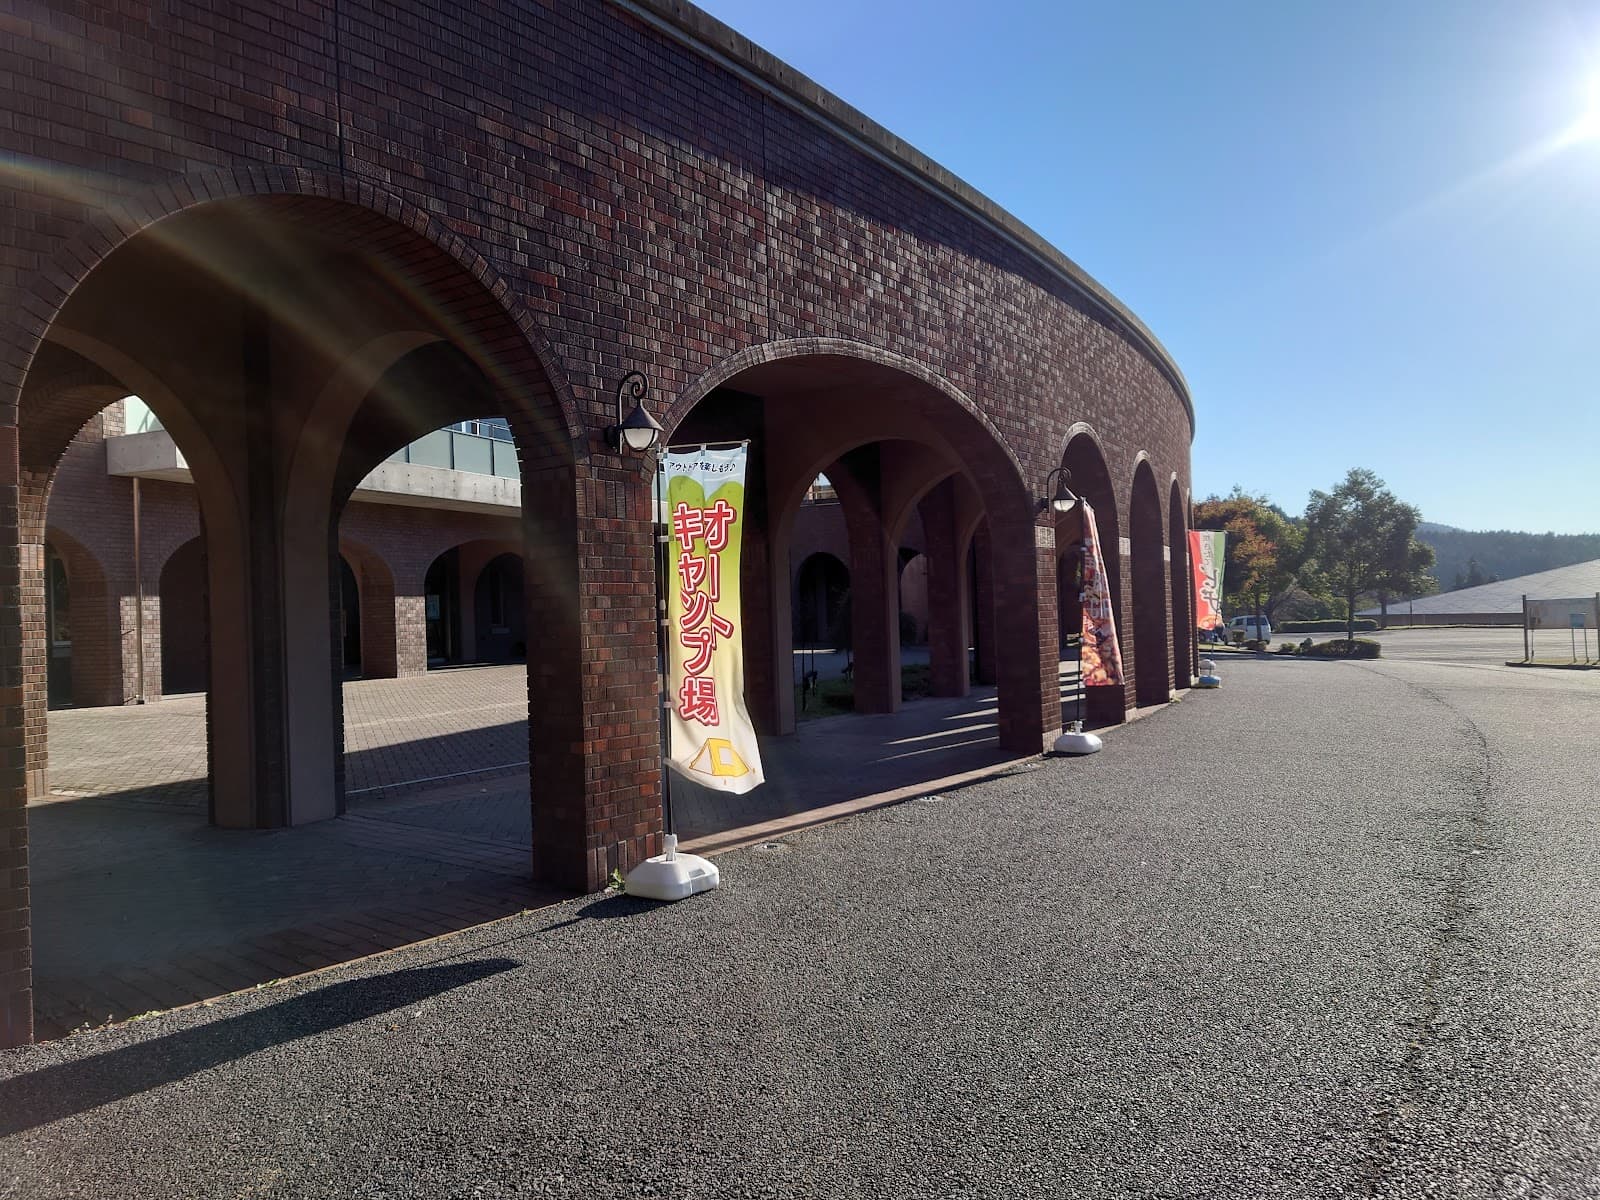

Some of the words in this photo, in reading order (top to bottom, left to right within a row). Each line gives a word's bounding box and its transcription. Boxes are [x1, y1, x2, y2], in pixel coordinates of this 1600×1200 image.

[673, 502, 720, 726] キャンプ場
[703, 501, 737, 650] オート
